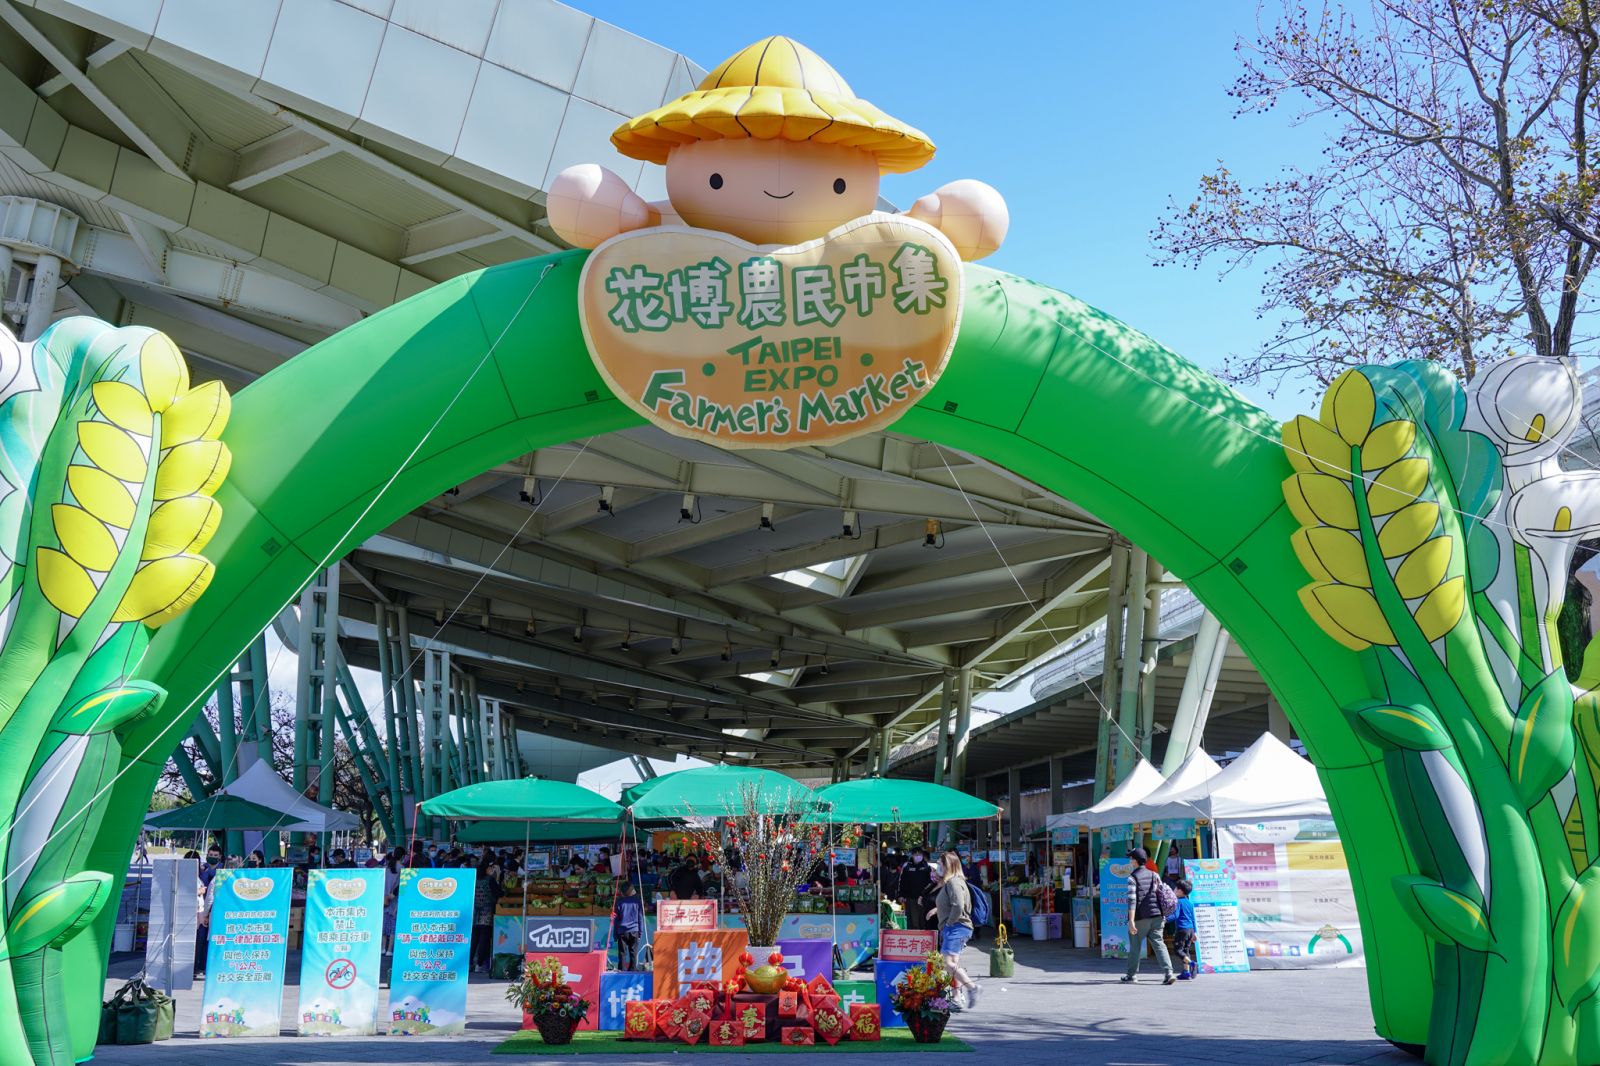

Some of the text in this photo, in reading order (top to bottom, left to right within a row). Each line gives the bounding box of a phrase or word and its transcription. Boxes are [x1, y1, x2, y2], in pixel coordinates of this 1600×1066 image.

[605, 242, 948, 333] 花博農民市集
[726, 335, 842, 366] TAIPEI
[743, 364, 839, 393] EXPO
[641, 358, 926, 436] Farmer's Market
[663, 908, 711, 923] 新年快樂
[226, 923, 272, 933] 進入本市集
[334, 919, 355, 930] 禁止
[411, 923, 456, 932] 進入本市集
[317, 931, 370, 943] 騎乘自行車
[529, 924, 590, 947] TAIPEI
[409, 949, 454, 959] 與他人保持
[884, 936, 932, 955] 年年有餘
[224, 950, 271, 960] 與他人保持
[217, 972, 272, 982] 社交安全距離
[403, 971, 457, 981] 社交安全距離
[629, 1011, 649, 1032] 福
[741, 1006, 762, 1028] 春
[855, 1012, 876, 1034] 福
